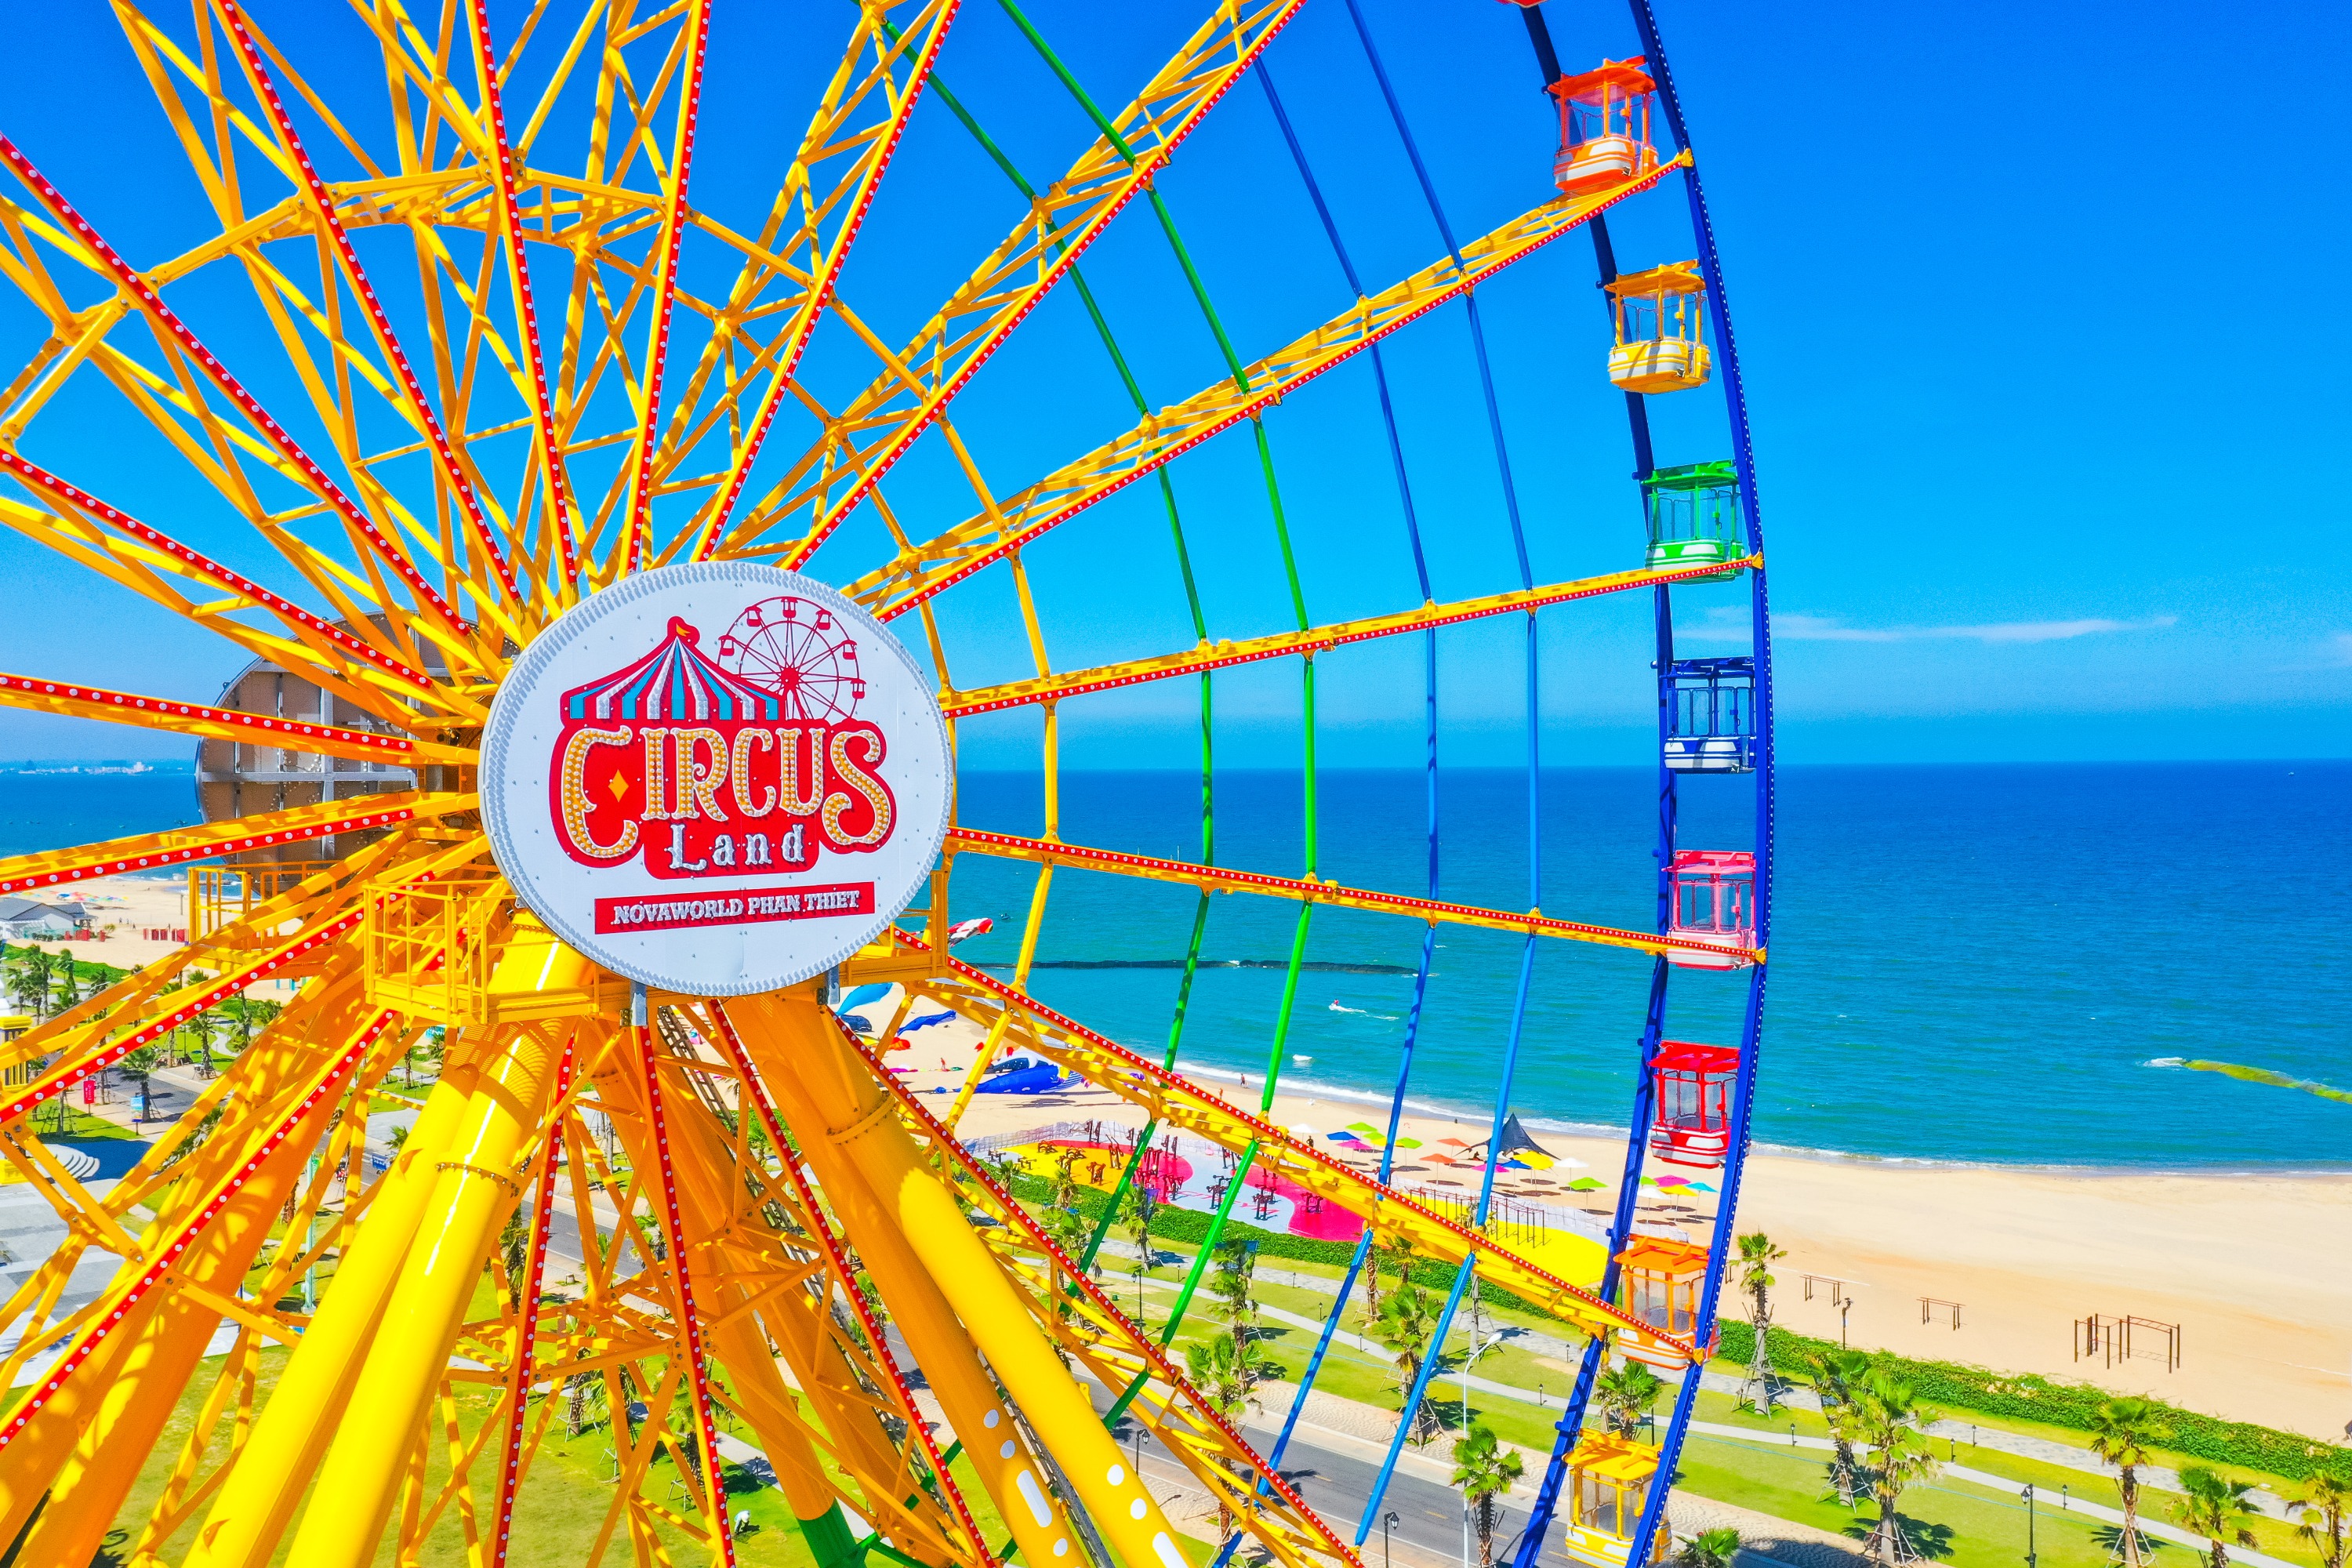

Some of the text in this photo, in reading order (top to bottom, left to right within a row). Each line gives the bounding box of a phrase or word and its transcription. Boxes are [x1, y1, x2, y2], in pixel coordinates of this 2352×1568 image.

[561, 725, 892, 858] CIRCUS
[668, 824, 805, 871] Land
[613, 891, 860, 924] NOVAWORLD PHAN THIET
